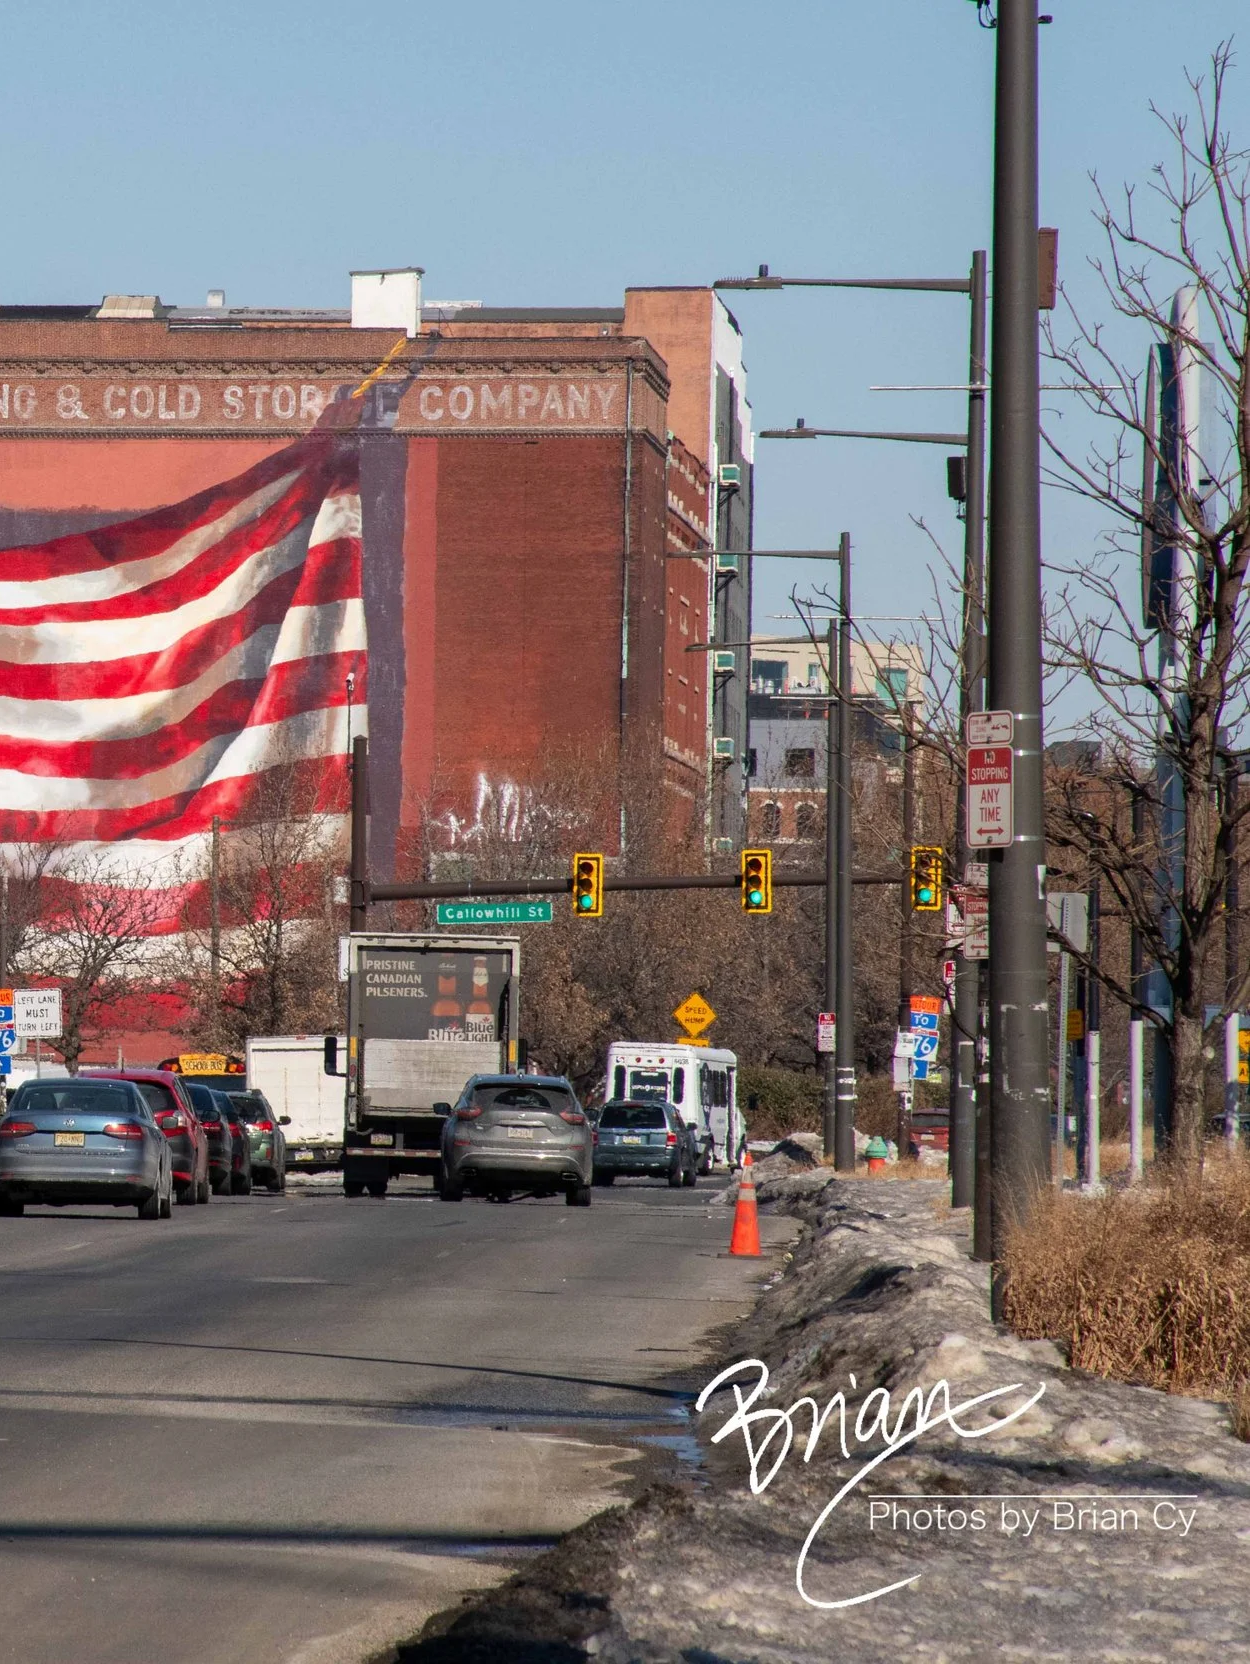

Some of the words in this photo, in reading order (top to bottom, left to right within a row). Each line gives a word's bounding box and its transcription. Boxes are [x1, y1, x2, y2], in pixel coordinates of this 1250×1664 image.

[56, 384, 89, 419] &
[103, 385, 202, 420] COLD
[419, 385, 619, 421] COMPANY
[984, 751, 996, 764] NO
[971, 767, 1009, 781] STOPPING
[980, 788, 1000, 804] ANY
[979, 807, 1002, 822] TIME
[445, 907, 520, 919] Callowhill
[528, 906, 544, 917] St
[366, 960, 416, 970] PRISTINE
[366, 973, 422, 984] CANADIAN
[366, 987, 428, 998] PILSENERS.
[17, 996, 35, 1005] LEFT
[38, 995, 57, 1004] LANE
[26, 1008, 48, 1018] MUST
[684, 1006, 707, 1015] SPEED
[914, 1014, 929, 1025] TO
[18, 1022, 37, 1032] TURN
[41, 1022, 58, 1031] LEFT
[466, 1021, 494, 1033] Blue
[466, 1033, 494, 1041] LIGHT
[914, 1035, 932, 1054] 76
